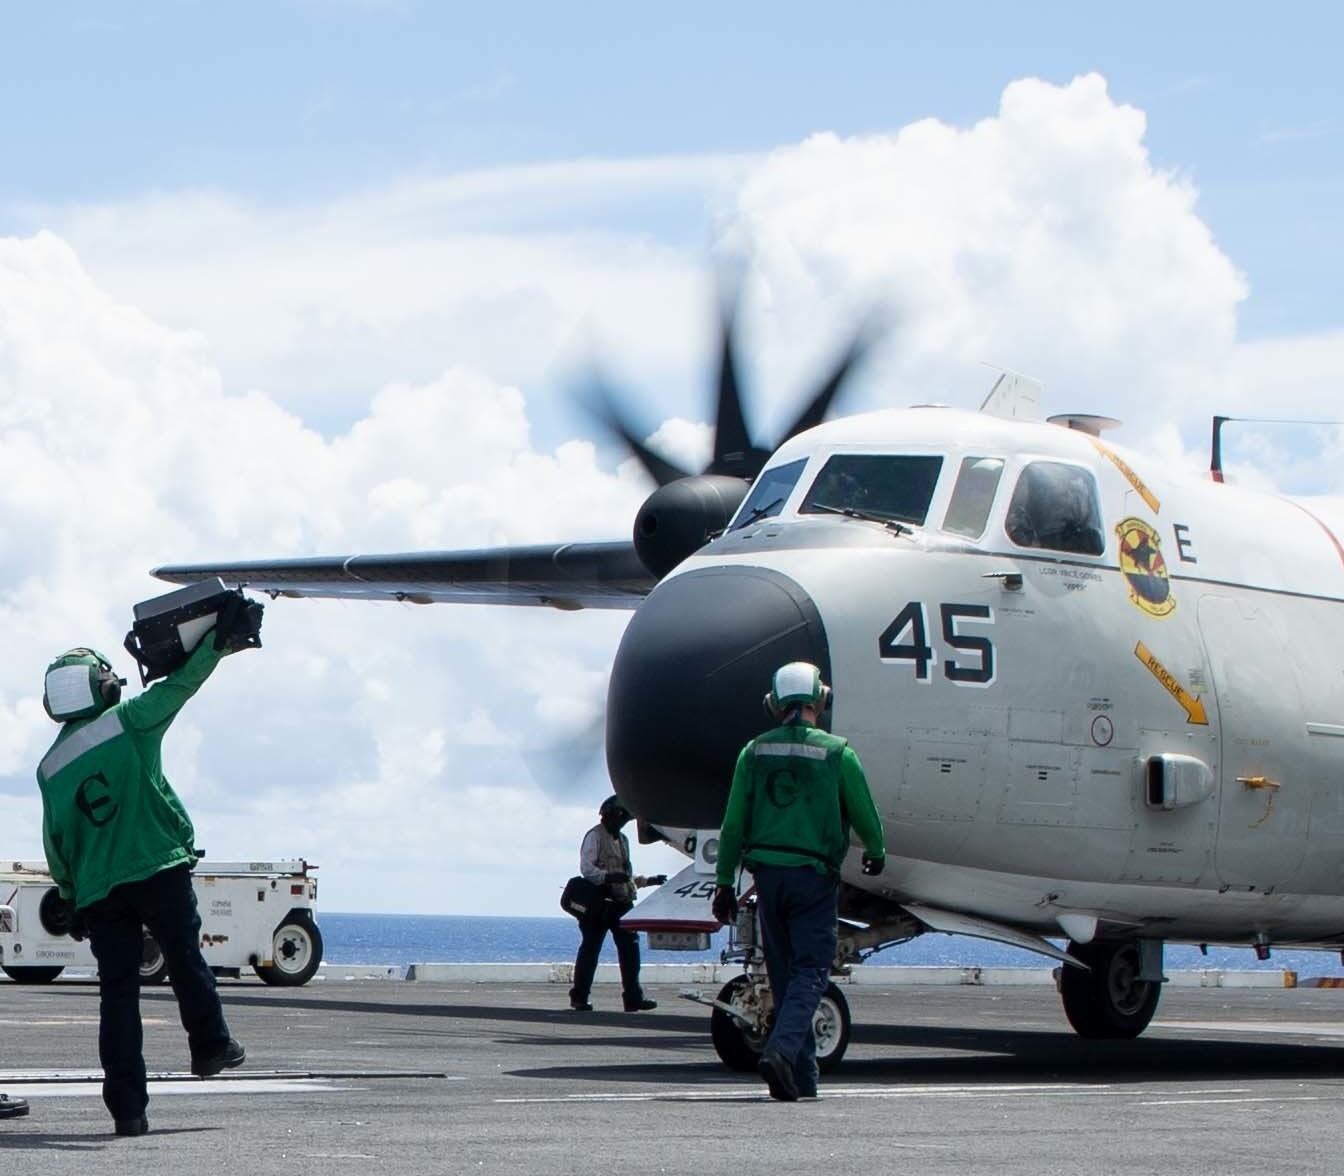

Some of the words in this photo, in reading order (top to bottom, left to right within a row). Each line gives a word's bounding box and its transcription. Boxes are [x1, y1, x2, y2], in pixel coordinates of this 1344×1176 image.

[1173, 523, 1197, 563] E
[879, 601, 995, 687] 45
[1148, 655, 1184, 696] RESCUE
